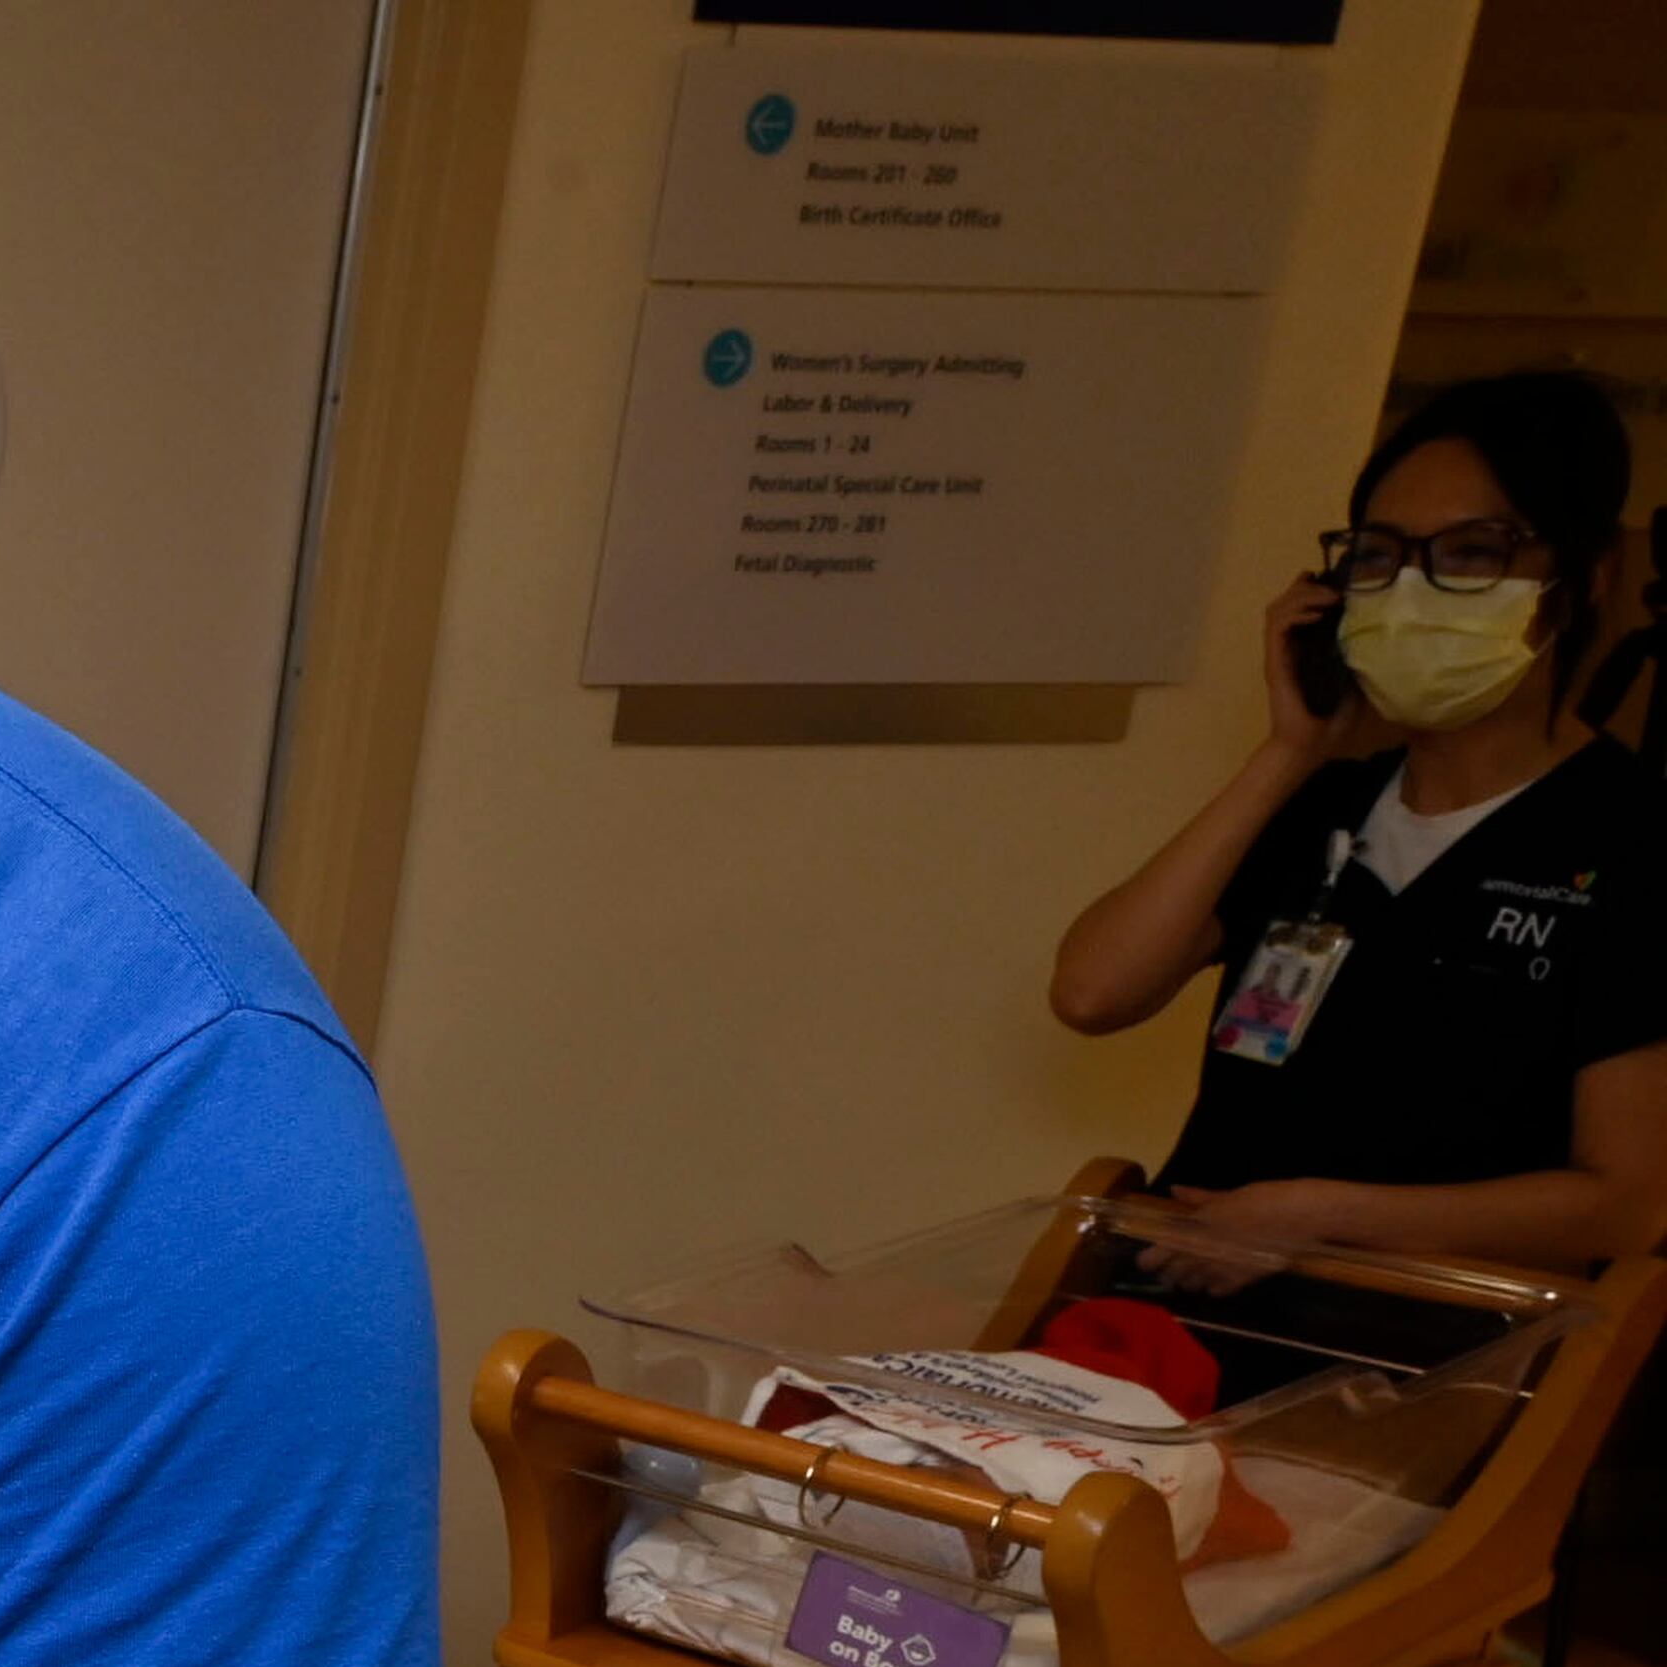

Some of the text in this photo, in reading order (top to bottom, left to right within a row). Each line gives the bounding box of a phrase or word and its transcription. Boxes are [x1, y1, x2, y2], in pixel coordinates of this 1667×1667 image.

[814, 118, 980, 144] Mother Baby Unit
[806, 161, 867, 181] Rooms
[799, 204, 1002, 228] Birth Certificate Office
[771, 353, 1026, 380] Women's Surgery Admitting
[763, 395, 913, 418] Labor & Delivery
[755, 434, 816, 453] Rooms
[748, 475, 985, 497] Perinatal Special Care Unit
[740, 514, 801, 533] Rooms
[734, 553, 877, 577] Fetal Diagnostic
[1487, 906, 1556, 948] RN
[836, 1614, 893, 1652] Baby
[828, 1641, 861, 1663] on
